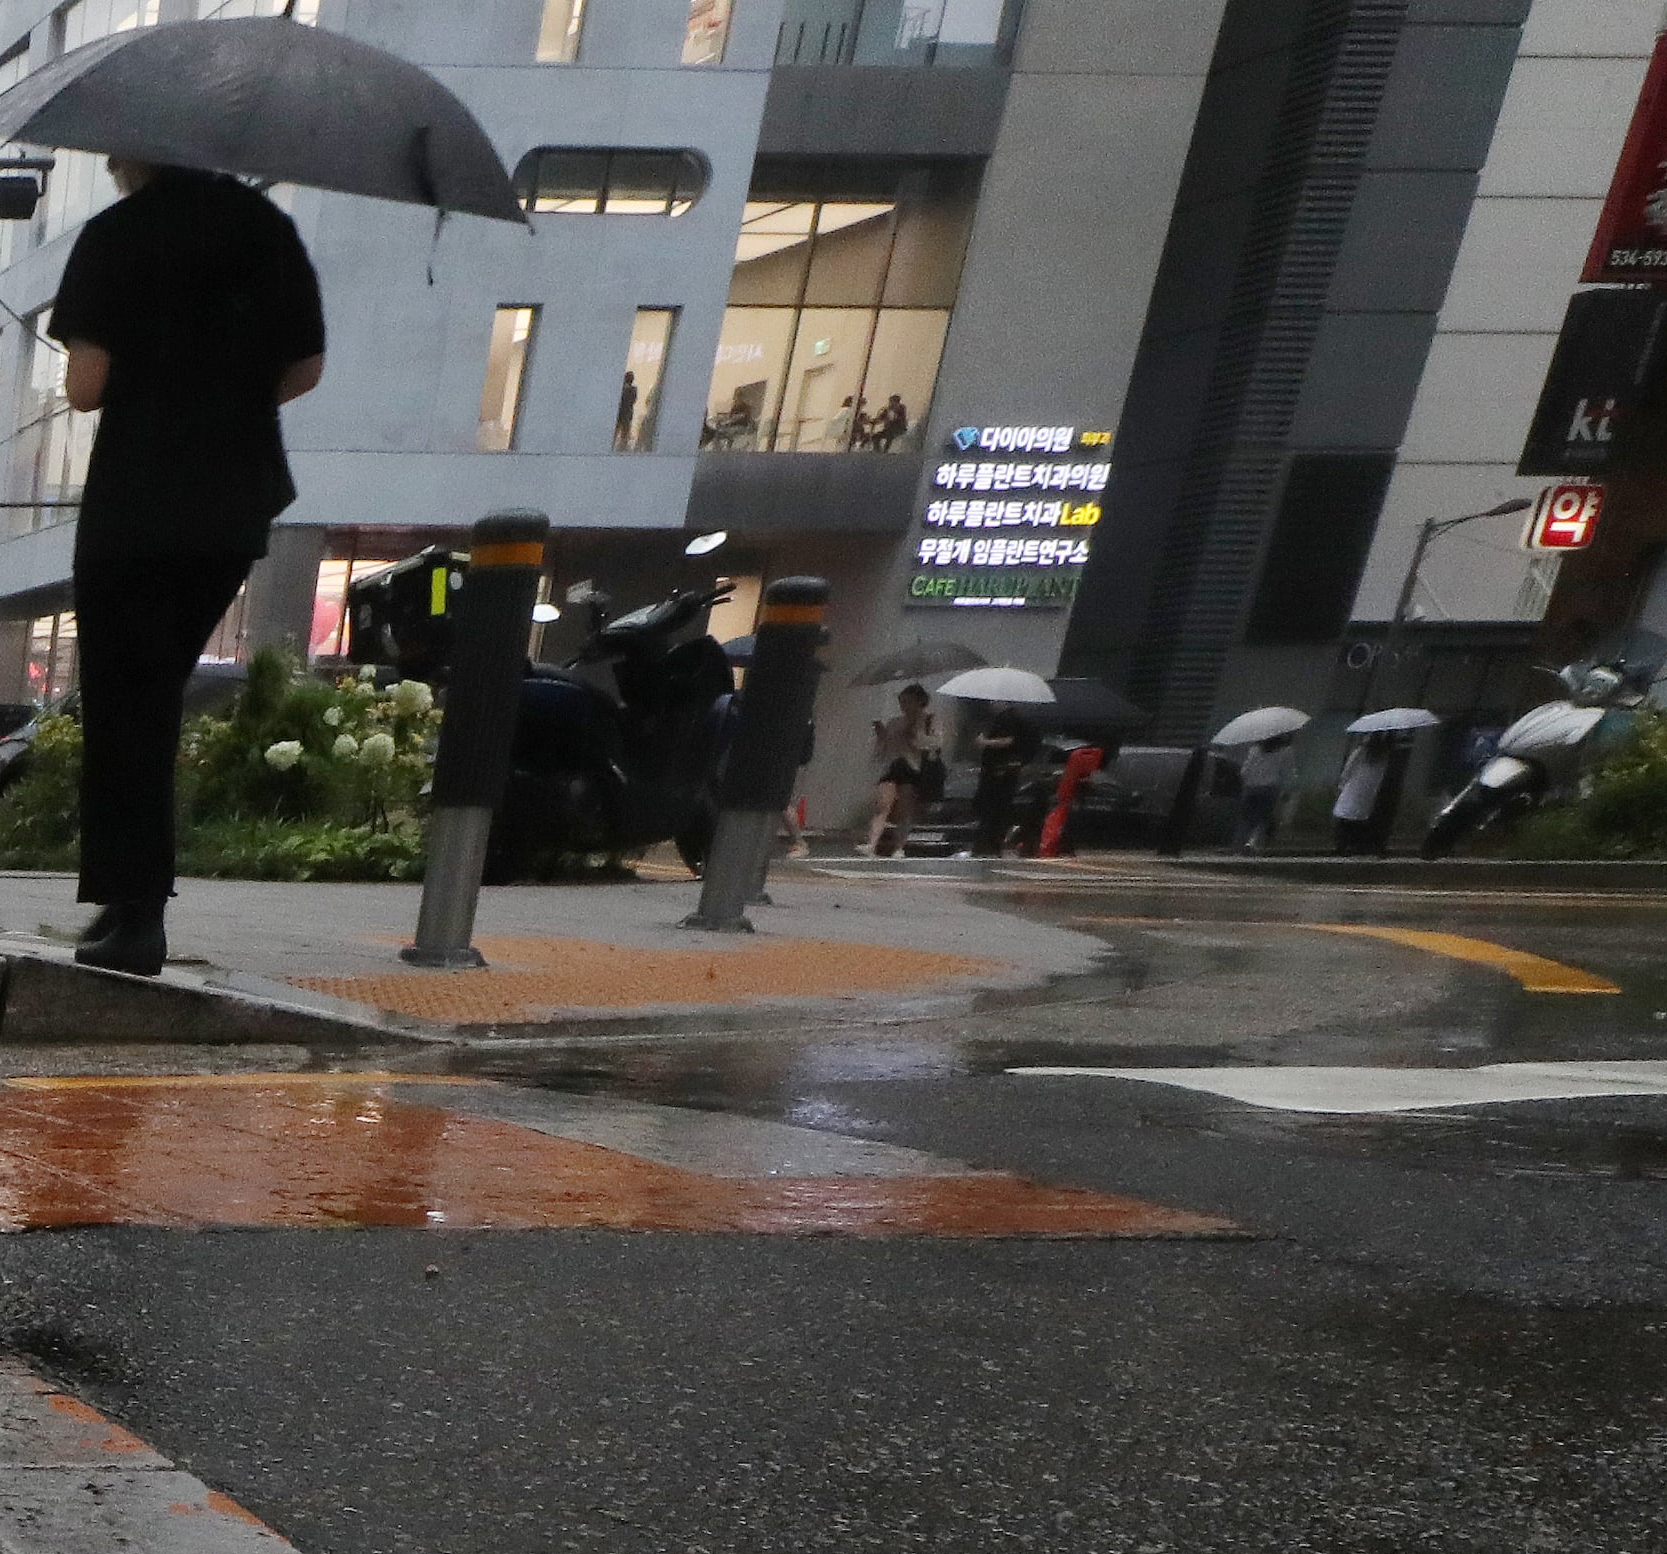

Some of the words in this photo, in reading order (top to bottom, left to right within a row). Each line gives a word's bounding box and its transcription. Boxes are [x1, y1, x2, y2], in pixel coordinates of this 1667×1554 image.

[980, 427, 1074, 452] 다이아의원
[935, 463, 1112, 491] 하루플란트치과의원
[1549, 490, 1602, 543] 약
[918, 538, 971, 565] 무절개
[972, 538, 1090, 566] 임플란트연구소
[911, 575, 956, 597] CAFE
